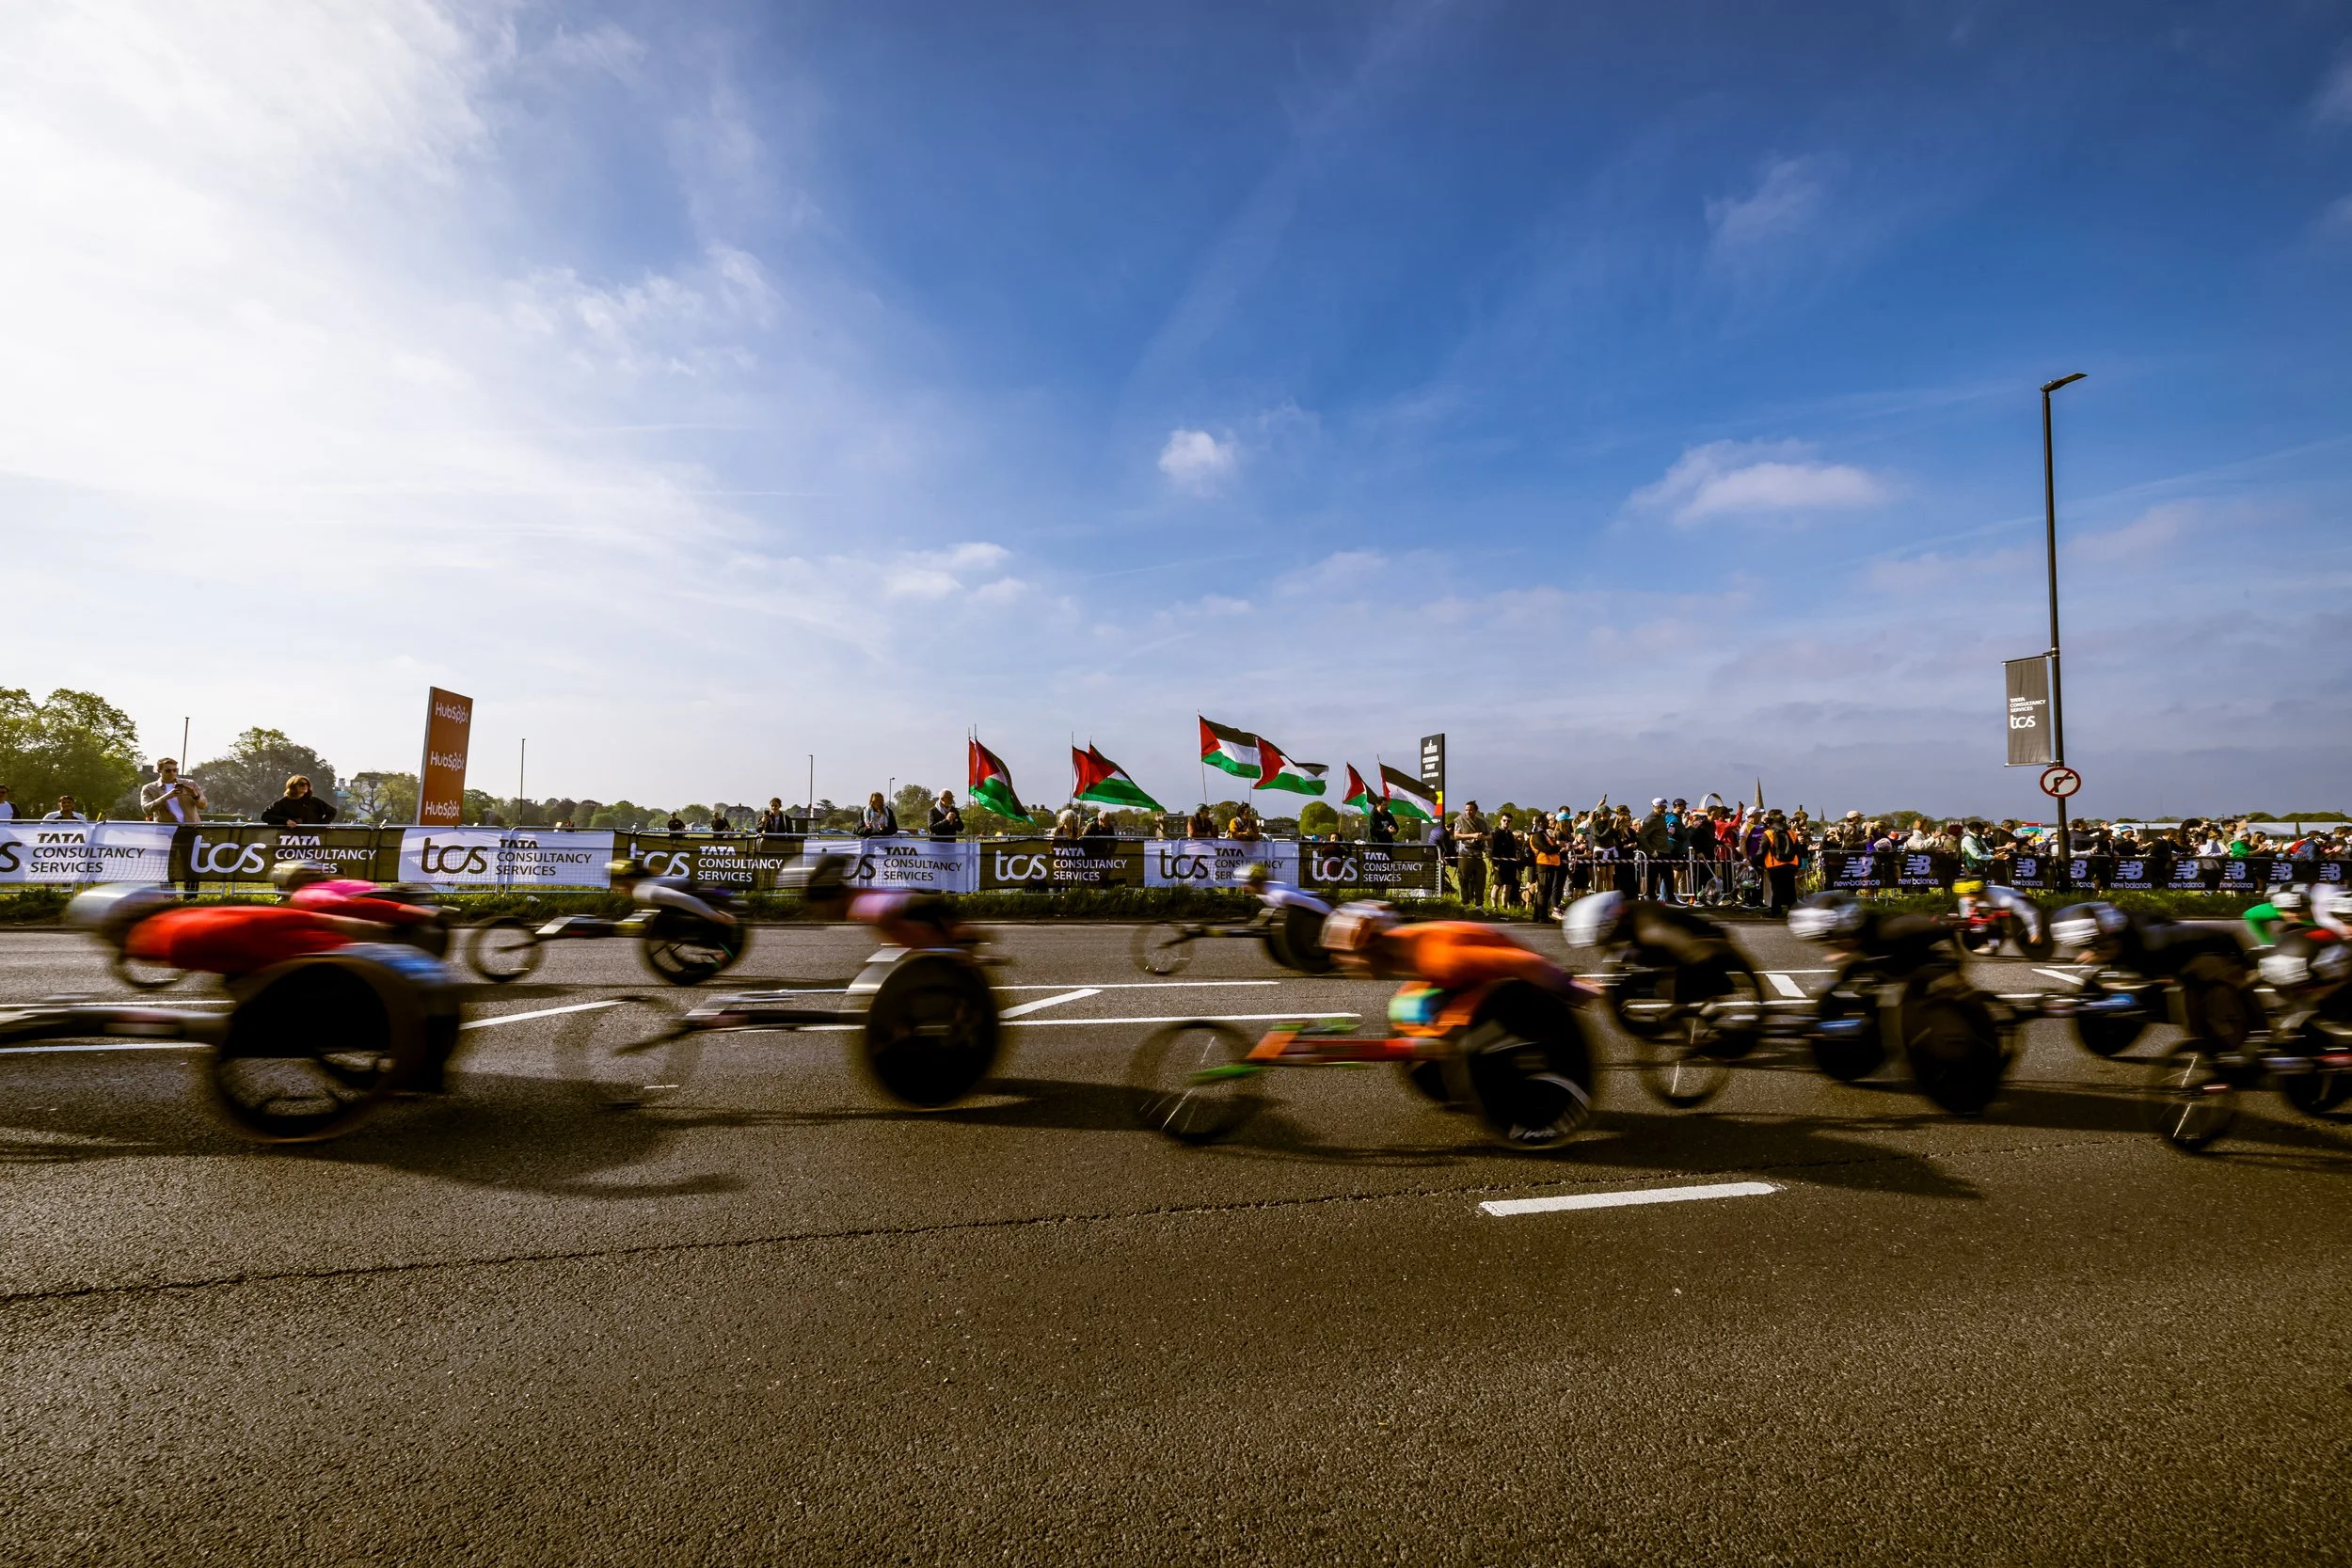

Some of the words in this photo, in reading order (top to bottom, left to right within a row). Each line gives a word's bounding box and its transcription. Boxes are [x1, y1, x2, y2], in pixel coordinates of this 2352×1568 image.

[435, 701, 469, 723] HubSpot
[2010, 715, 2036, 729] tcs
[430, 751, 464, 771] HubSpot
[425, 800, 460, 819] HubSpot
[38, 833, 86, 843] TATA
[278, 835, 320, 846] TATA
[499, 839, 538, 848] TATA
[32, 847, 146, 858] CONSULTANCY
[190, 834, 266, 874] tcs
[275, 848, 376, 860] CONSULTANCY
[421, 837, 487, 874] tcs
[699, 846, 736, 855] TATA
[884, 847, 918, 856] TATA
[1053, 847, 1085, 857] TATA
[1215, 847, 1244, 857] TATA
[1364, 851, 1390, 861] TATA
[497, 851, 592, 863] CONSULTANCY
[31, 862, 103, 873] SERVICES
[698, 858, 783, 869] CONSULTANCY
[883, 859, 961, 871] CONSULTANCY
[995, 849, 1047, 881] tcs
[1053, 859, 1127, 869] CONSULTANCY
[1160, 848, 1208, 879] tcs
[1312, 849, 1358, 881] tcs
[1364, 863, 1423, 872] CONSULTANCY
[495, 864, 556, 876] SERVICES
[883, 870, 934, 881] SERVICES
[697, 870, 752, 882] SERVICES
[1053, 871, 1100, 881] SERVICES
[1363, 873, 1402, 882] SERVICES
